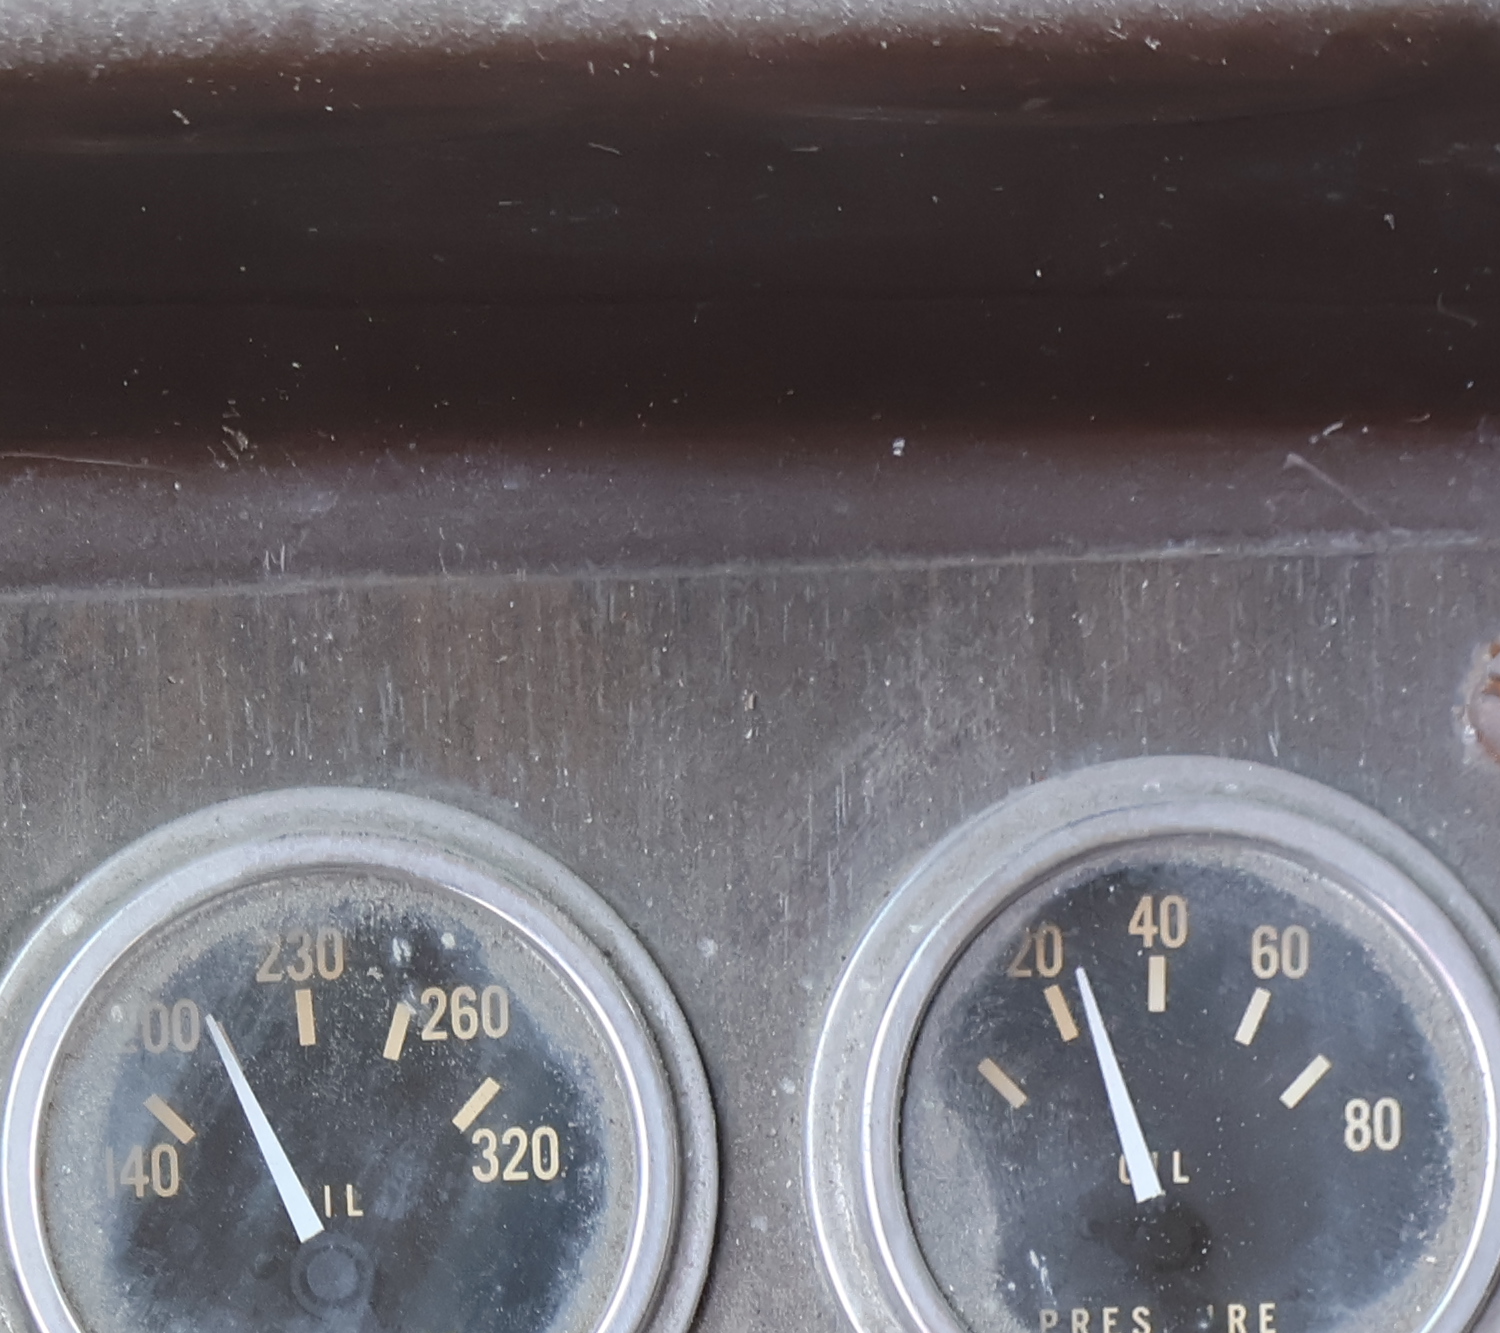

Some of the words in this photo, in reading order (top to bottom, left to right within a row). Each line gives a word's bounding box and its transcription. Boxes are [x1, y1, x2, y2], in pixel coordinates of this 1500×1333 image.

[1128, 894, 1189, 949] 40
[255, 931, 344, 983] 230
[1006, 924, 1064, 979] 20
[1249, 925, 1310, 980] 60
[419, 985, 510, 1041] 260
[1343, 1097, 1401, 1152] 80
[104, 1143, 180, 1200] 140
[471, 1126, 560, 1183] 320
[302, 1184, 365, 1219] IL
